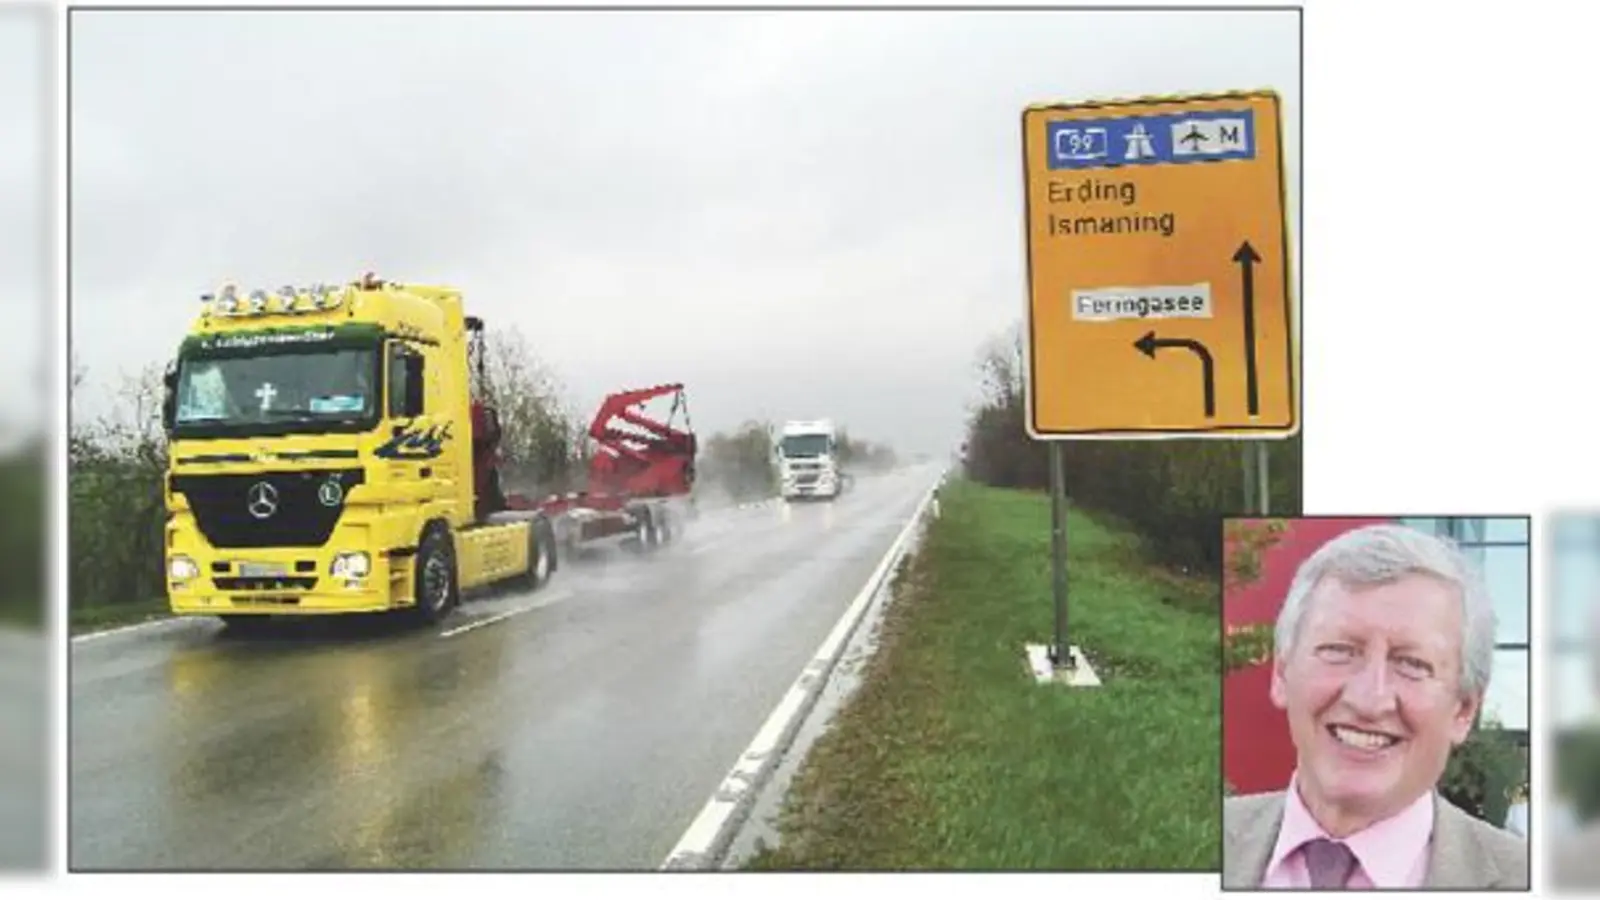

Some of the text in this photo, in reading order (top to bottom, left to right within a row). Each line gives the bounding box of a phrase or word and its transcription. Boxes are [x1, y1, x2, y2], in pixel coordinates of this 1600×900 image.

[1068, 133, 1093, 154] 99
[1219, 125, 1239, 144] M
[1048, 178, 1135, 206] Erding
[1048, 211, 1174, 237] Ismaning
[1077, 295, 1204, 318] Feringasee
